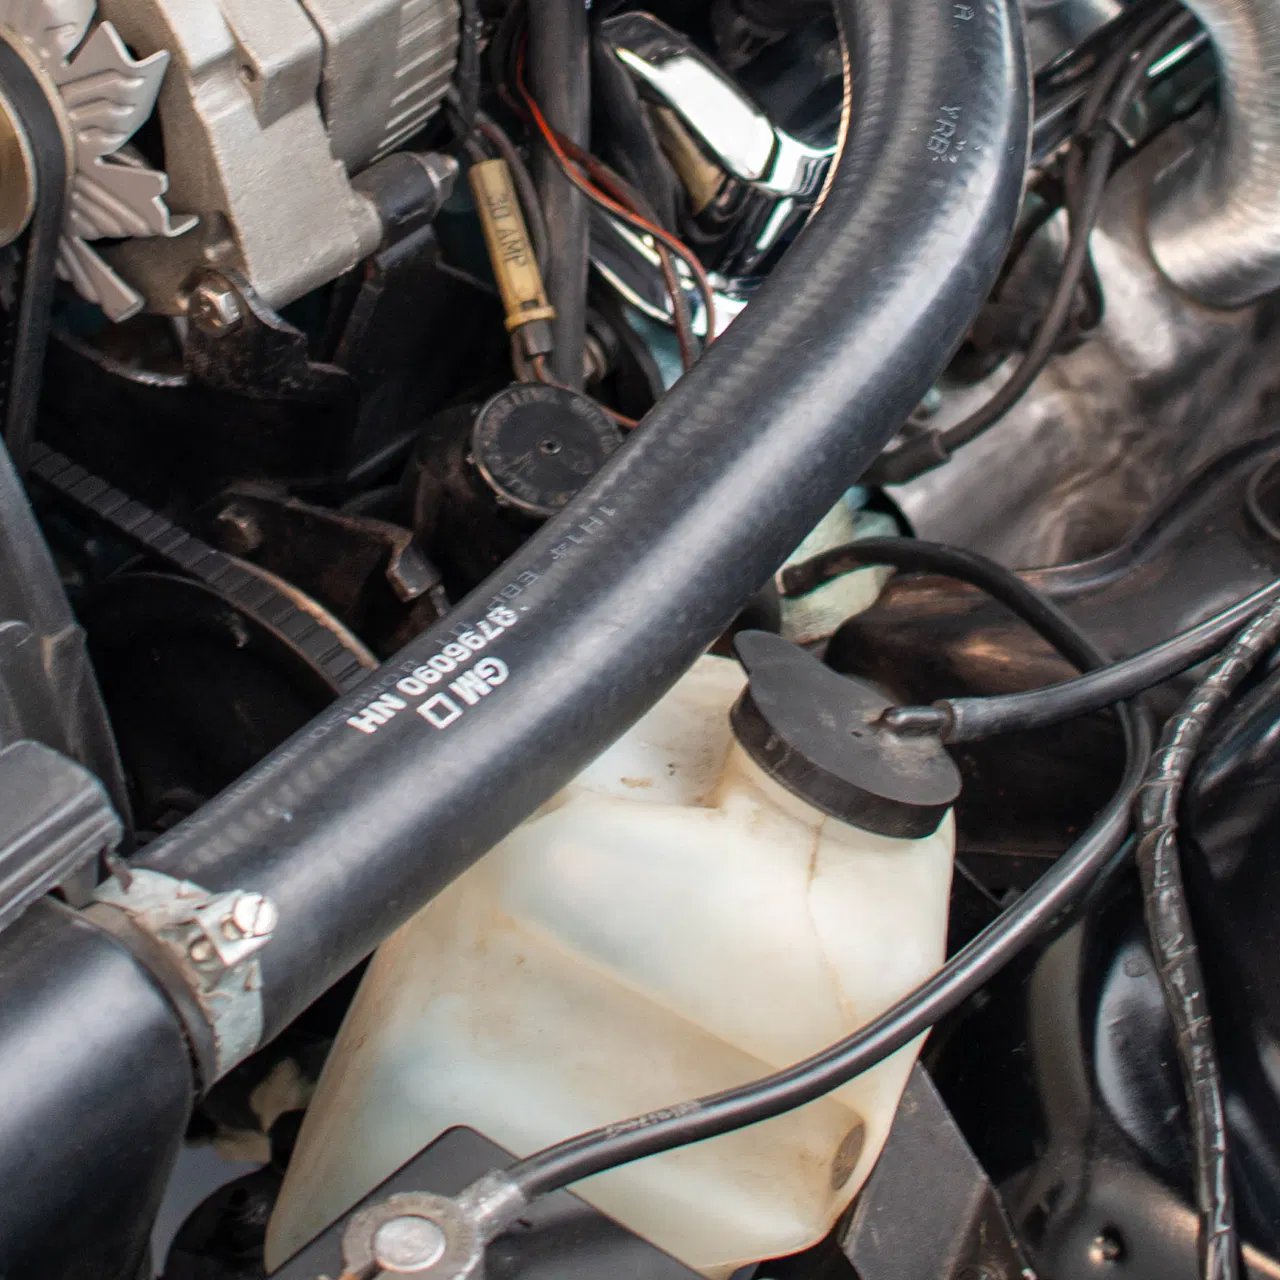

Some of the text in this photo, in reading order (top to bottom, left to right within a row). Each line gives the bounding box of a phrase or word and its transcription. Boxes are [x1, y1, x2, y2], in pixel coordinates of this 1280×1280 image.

[496, 228, 528, 268] AMP
[448, 656, 510, 706] GM
[346, 693, 408, 735] NH
